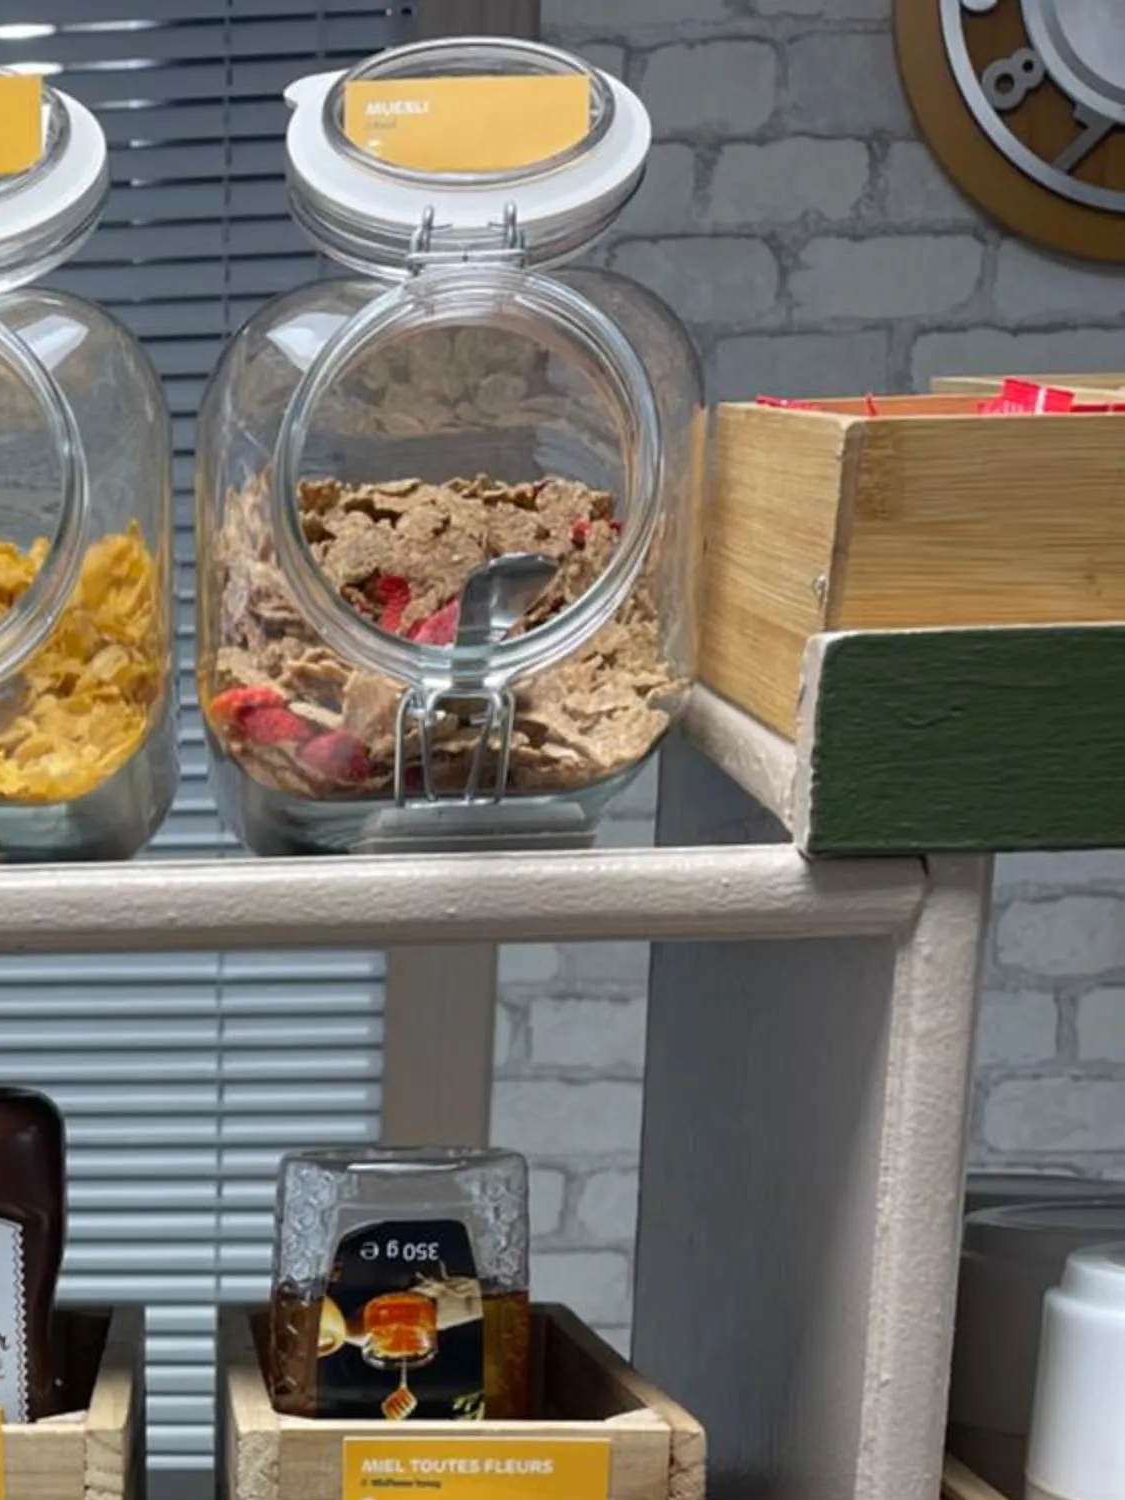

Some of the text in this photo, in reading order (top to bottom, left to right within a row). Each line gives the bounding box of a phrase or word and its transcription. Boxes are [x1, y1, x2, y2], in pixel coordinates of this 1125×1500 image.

[365, 100, 429, 115] MUESLI
[386, 1239, 399, 1257] g
[403, 1242, 440, 1261] 350
[361, 1458, 555, 1474] MIEL TOUTES FLEURS
